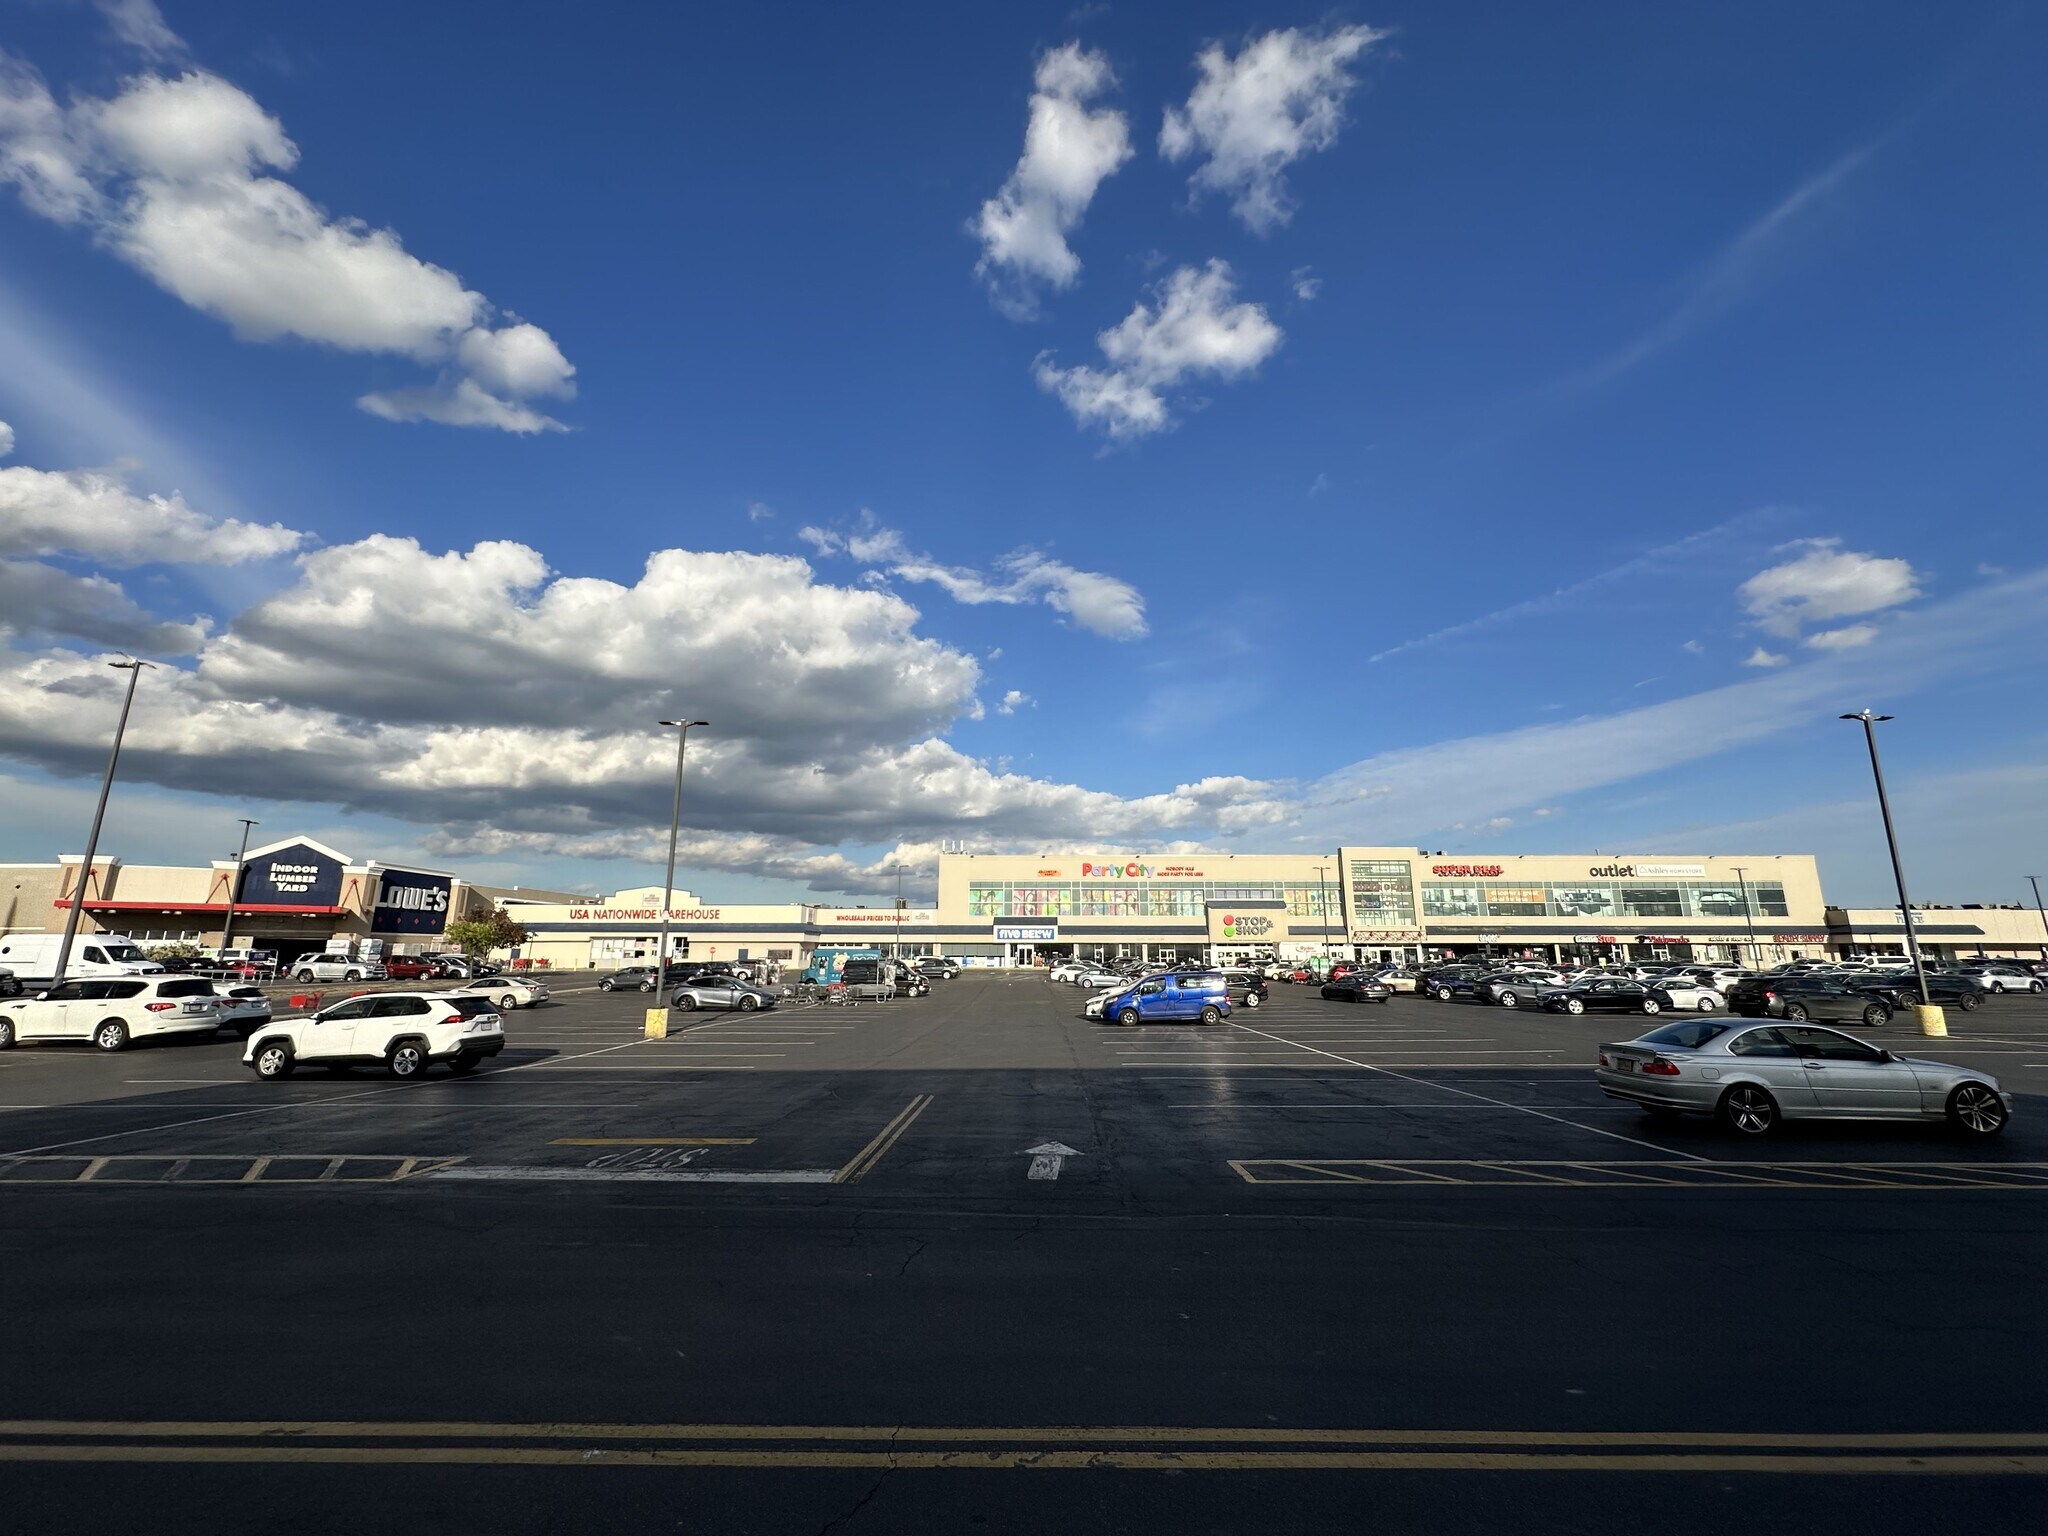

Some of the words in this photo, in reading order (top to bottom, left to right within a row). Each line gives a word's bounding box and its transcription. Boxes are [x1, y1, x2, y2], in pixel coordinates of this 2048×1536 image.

[271, 862, 319, 874] INDOOR
[1082, 862, 1125, 878] Party
[1125, 862, 1155, 878] City
[1432, 865, 1471, 874] SUPER
[1473, 865, 1504, 874] DEAL
[1589, 863, 1635, 877] outlet
[269, 872, 317, 884] LUMBER
[276, 882, 309, 893] YARD
[376, 881, 448, 912] LOWE'S
[570, 909, 589, 920] USA
[593, 909, 657, 920] NATIONWIDE
[1235, 916, 1268, 926] STOP
[1266, 920, 1274, 928] &
[1235, 926, 1268, 935] SHOP
